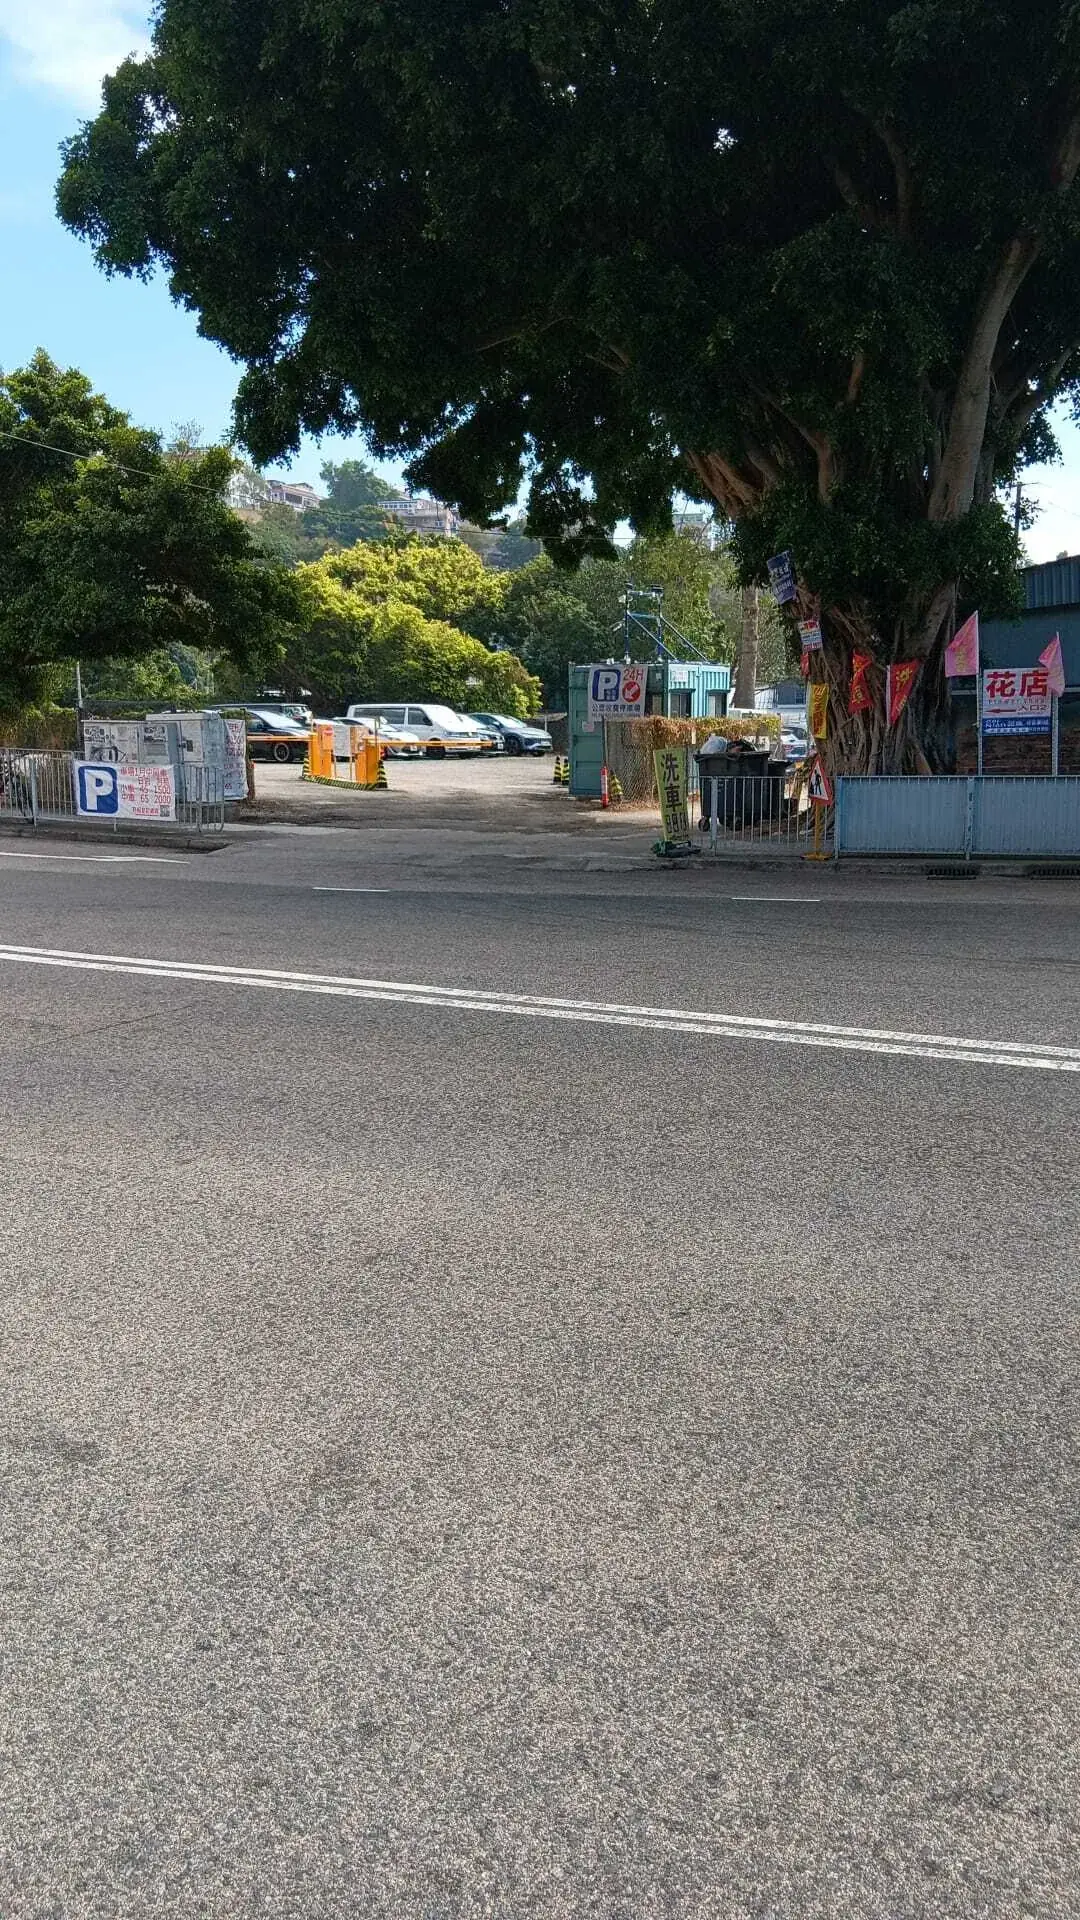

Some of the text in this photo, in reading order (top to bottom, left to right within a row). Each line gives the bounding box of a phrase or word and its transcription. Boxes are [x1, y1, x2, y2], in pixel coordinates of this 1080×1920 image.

[597, 671, 618, 700] P
[623, 668, 644, 680] 24H
[986, 671, 1049, 698] 花店
[84, 768, 114, 811] P
[661, 753, 682, 812] 洗車
